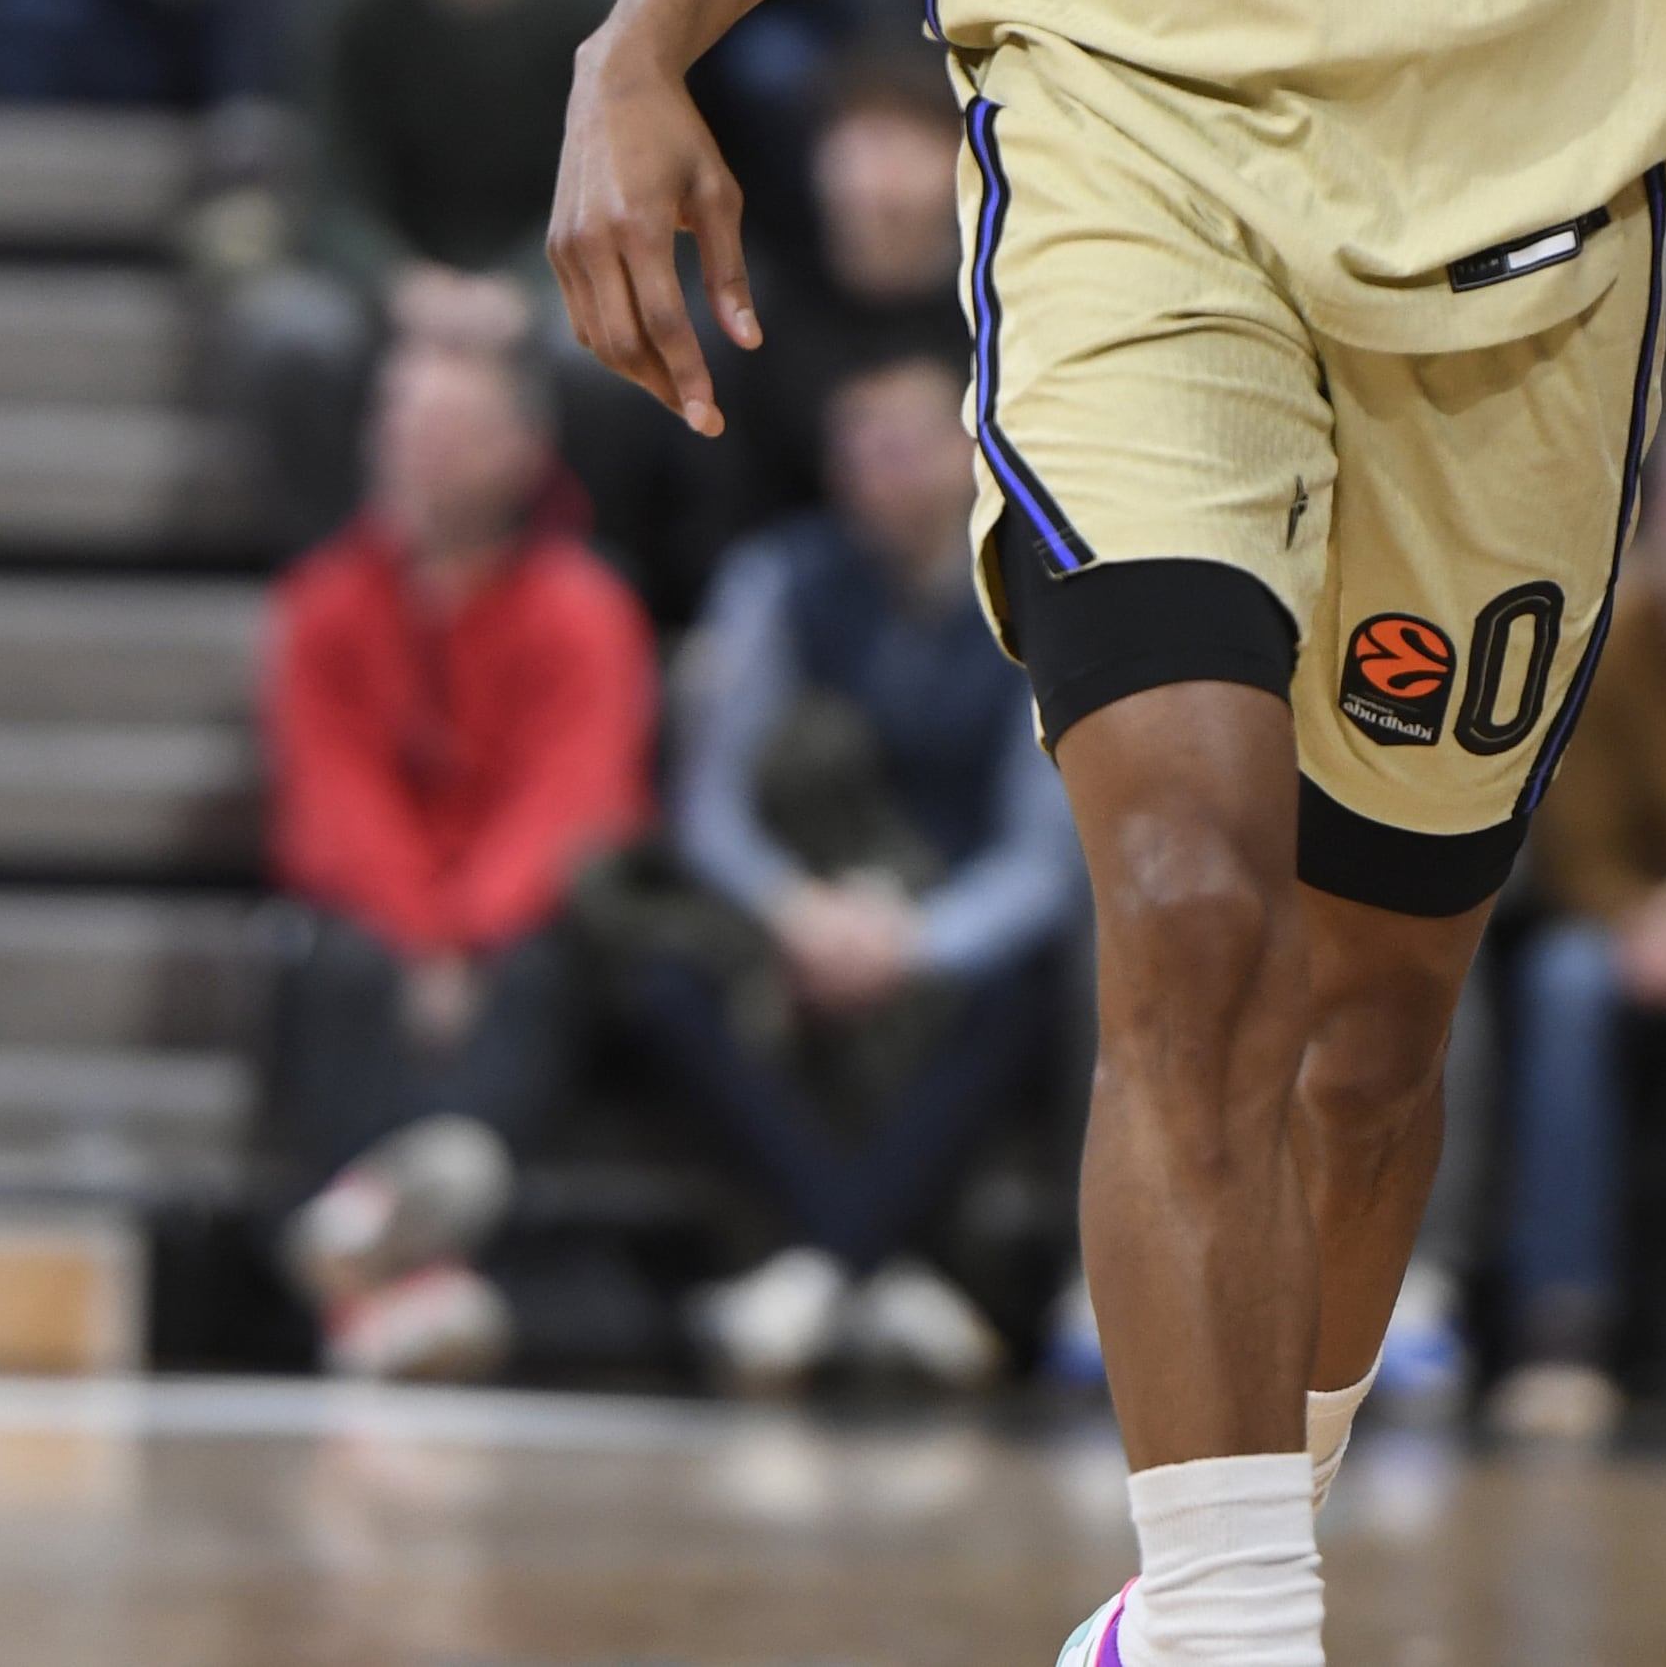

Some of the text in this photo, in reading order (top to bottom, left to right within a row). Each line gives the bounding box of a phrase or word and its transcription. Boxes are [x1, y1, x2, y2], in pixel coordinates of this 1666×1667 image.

[1343, 701, 1377, 723] abu
[1378, 714, 1434, 741] dhabi
[1453, 580, 1565, 756] 0
